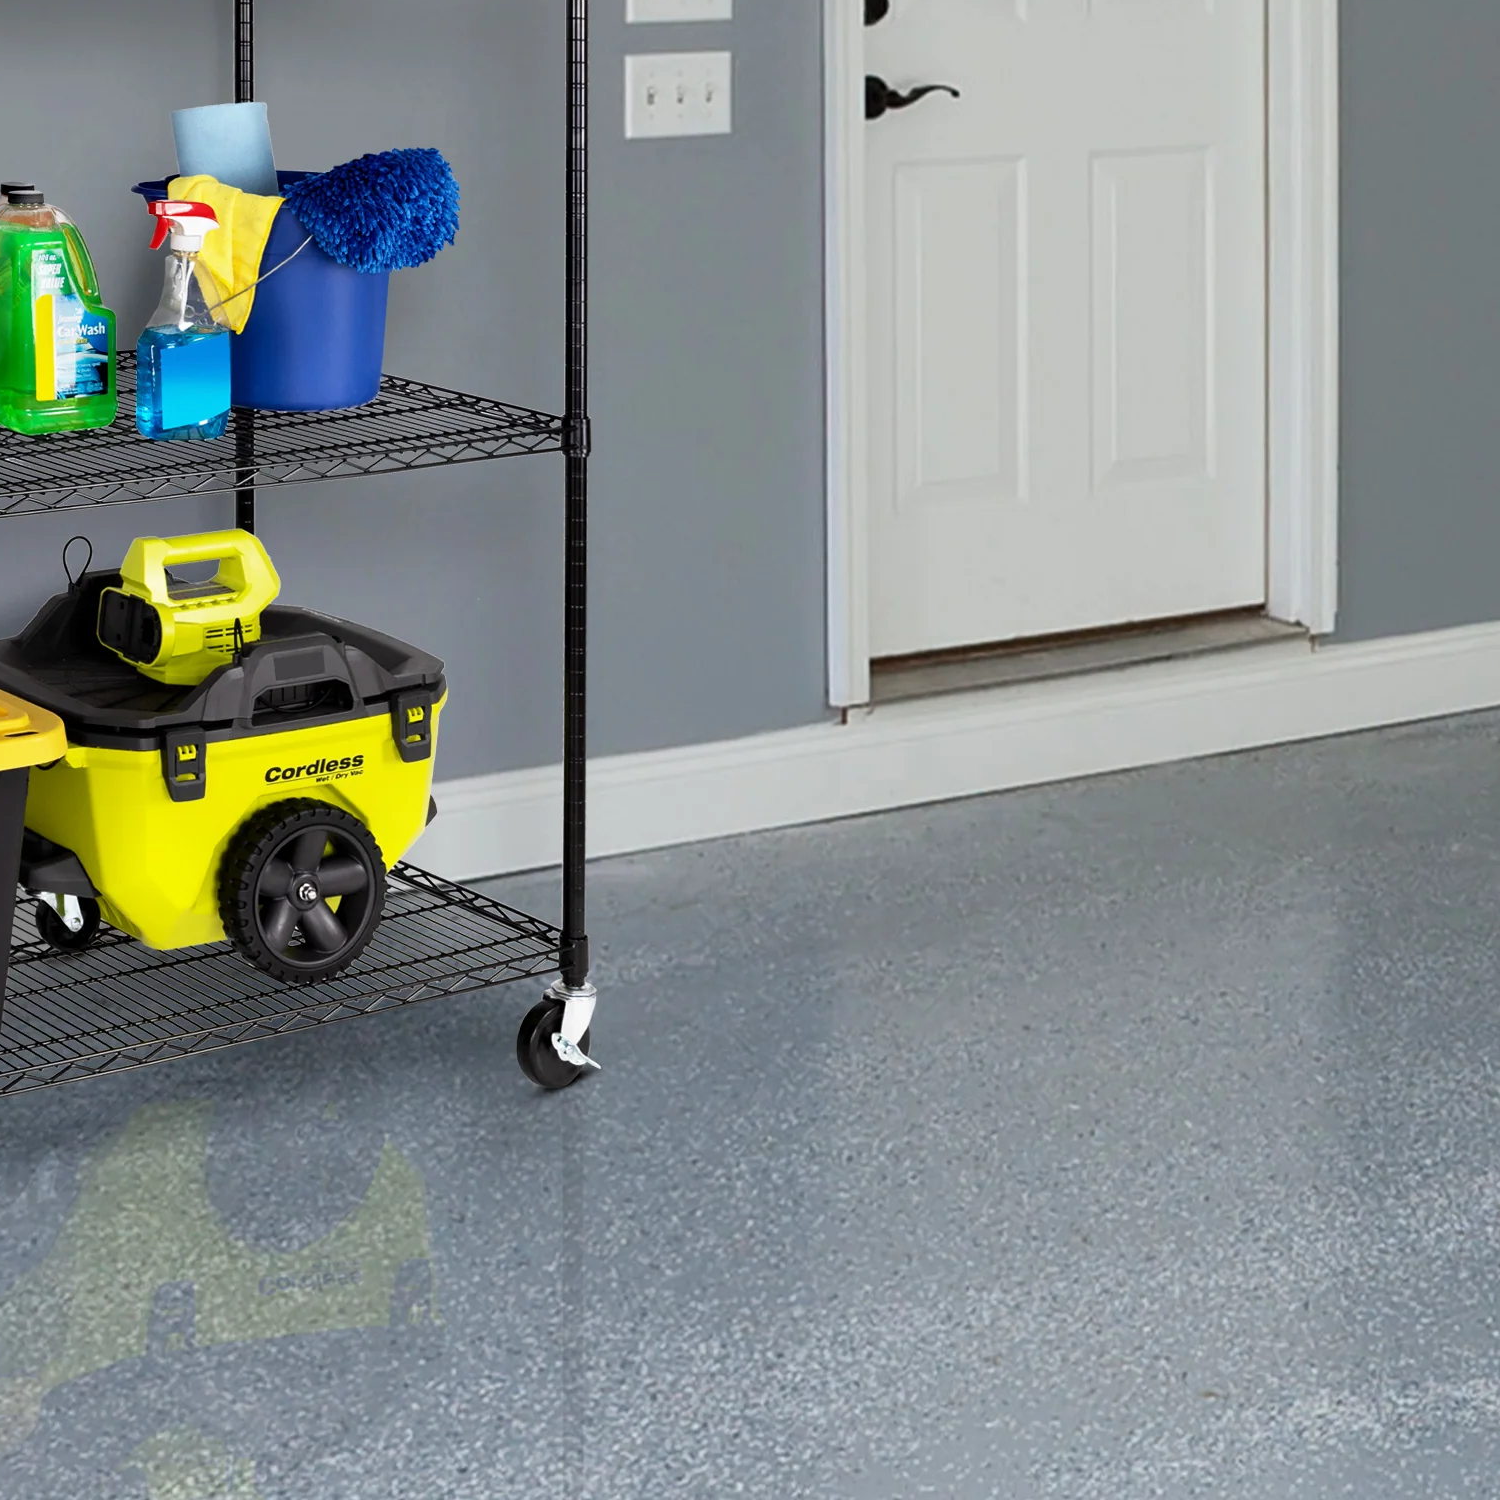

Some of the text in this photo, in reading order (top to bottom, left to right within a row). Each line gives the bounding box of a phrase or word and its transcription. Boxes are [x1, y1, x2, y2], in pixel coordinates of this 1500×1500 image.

[38, 263, 62, 275] SUPER
[40, 277, 65, 289] VALUE
[57, 322, 105, 338] Car Wash
[265, 755, 364, 782] Cordless
[316, 775, 330, 783] Wet
[350, 769, 364, 777] Vac
